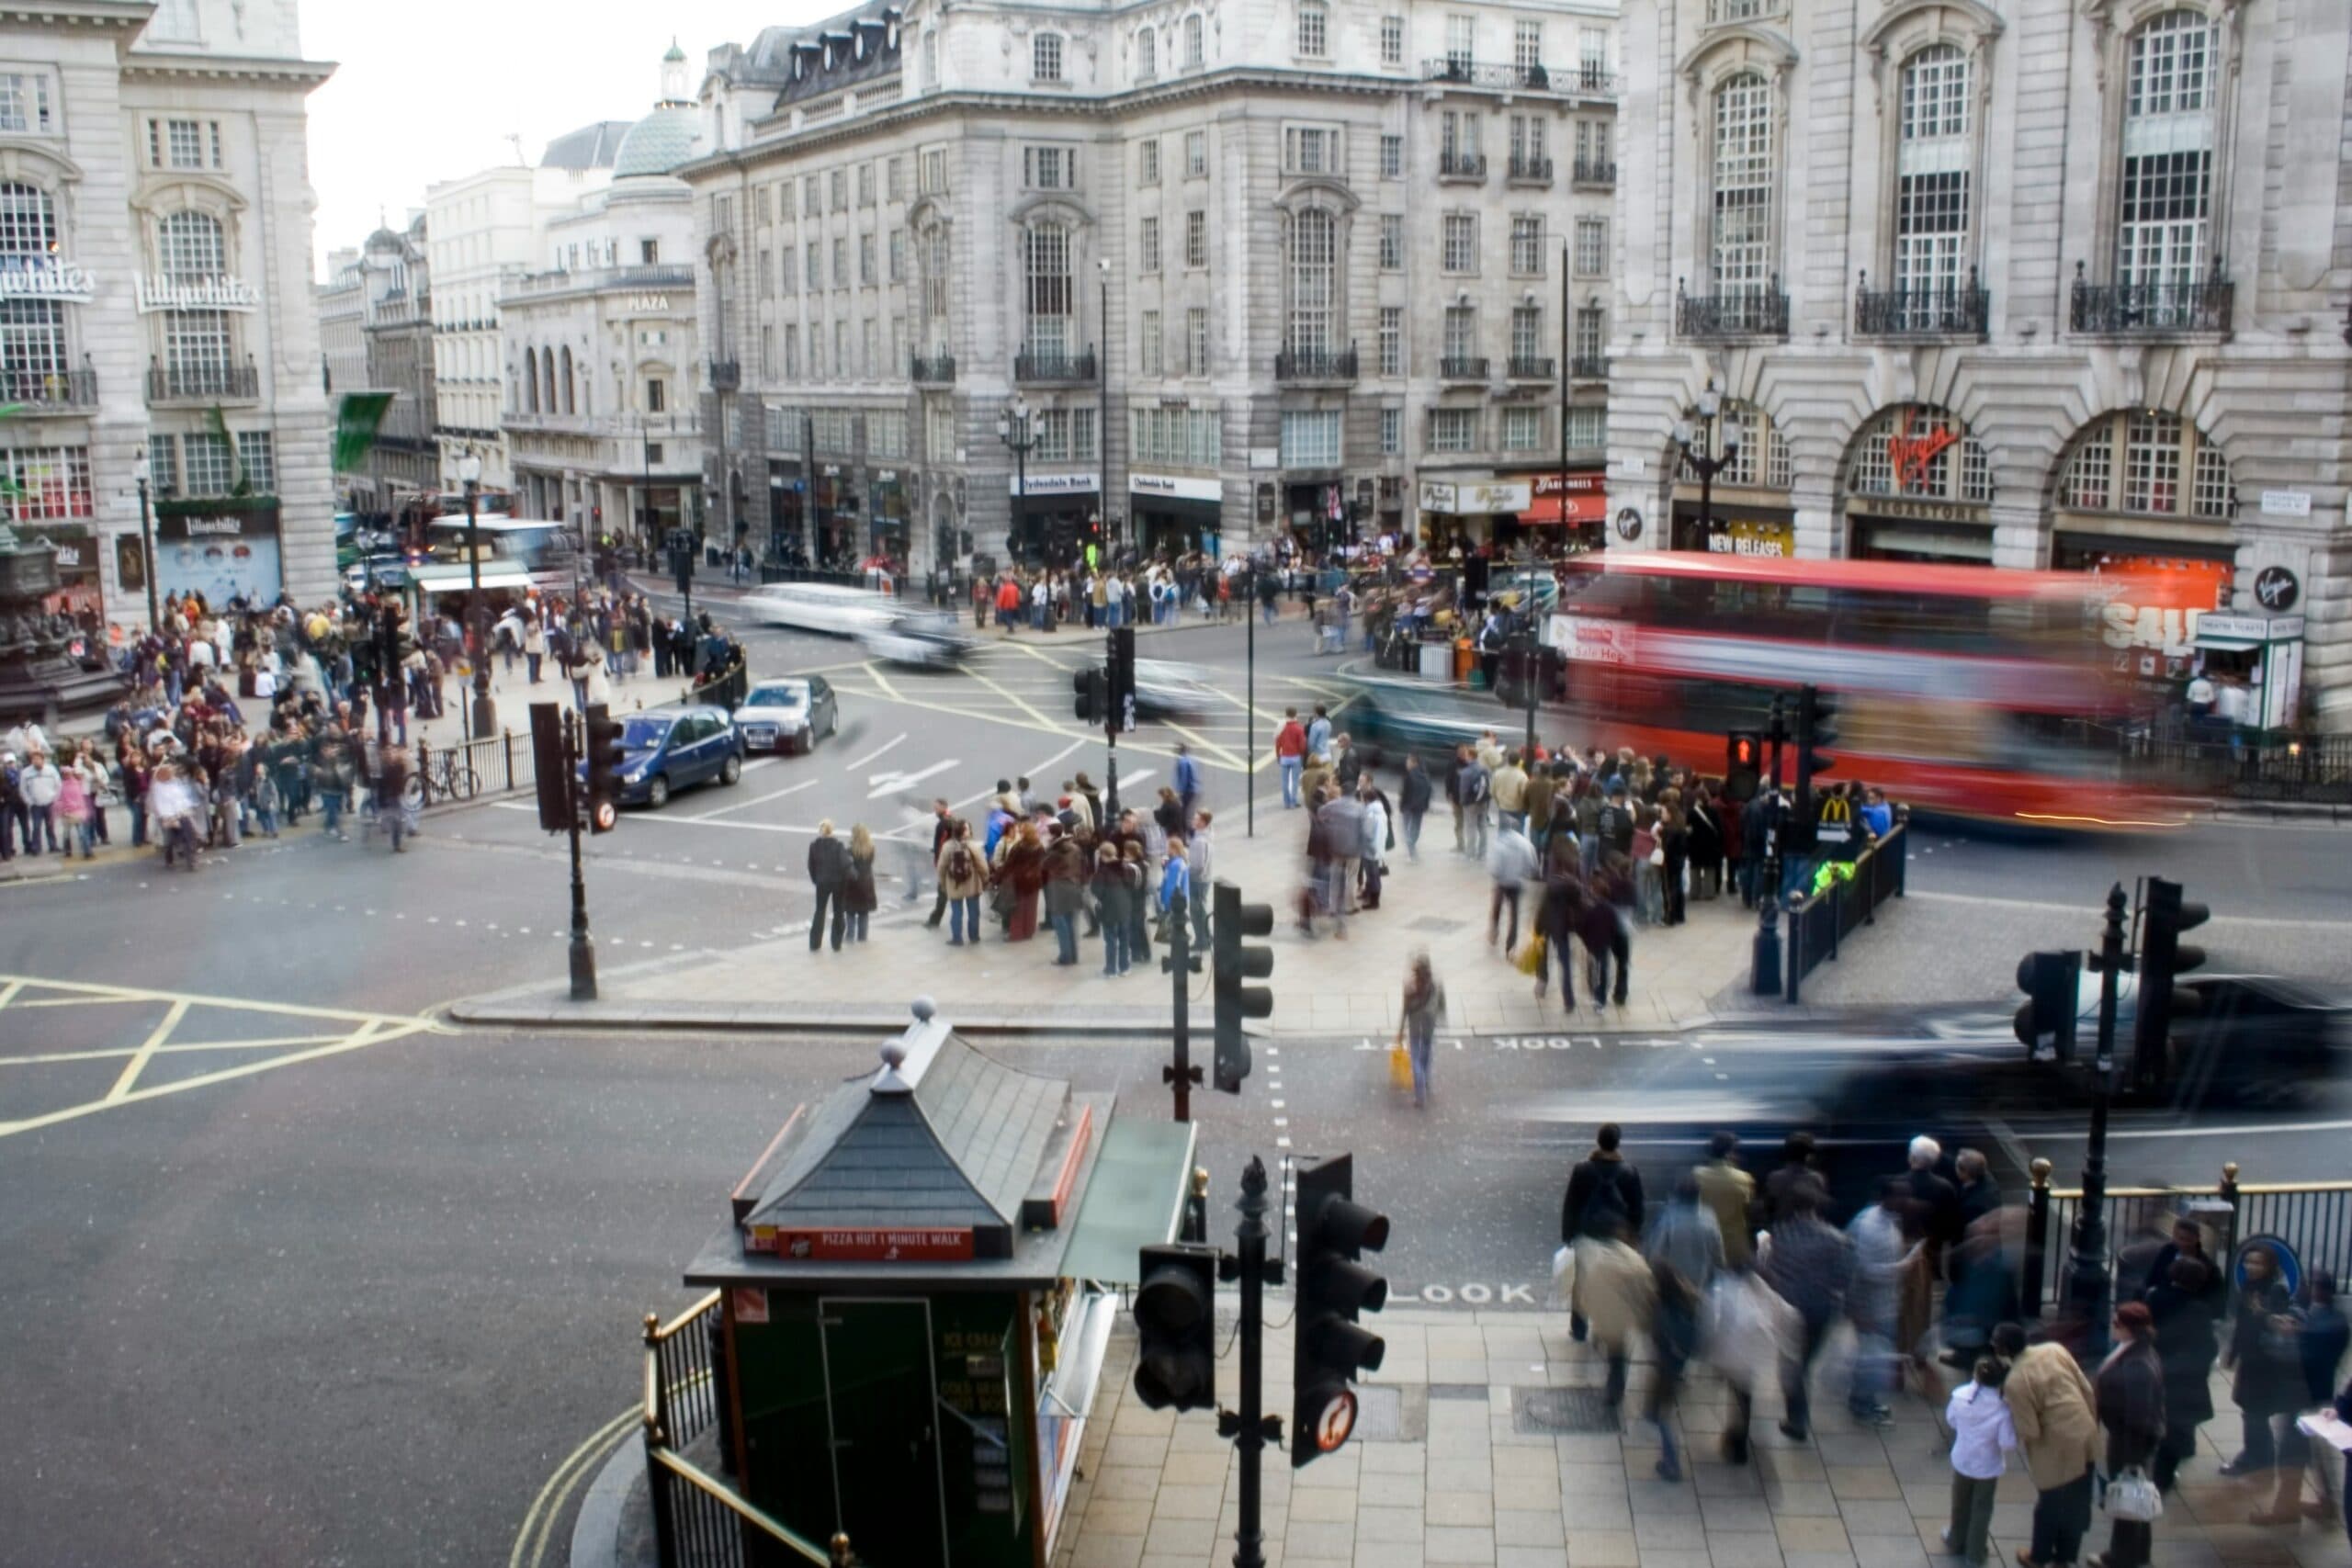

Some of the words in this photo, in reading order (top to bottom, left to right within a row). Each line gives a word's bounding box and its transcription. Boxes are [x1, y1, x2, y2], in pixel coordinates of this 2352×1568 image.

[628, 294, 669, 310] PLAZA
[1888, 406, 1959, 491] Virgin
[1069, 476, 1092, 488] Bank
[1867, 500, 1981, 521] MEGASTORE
[1709, 533, 1733, 552] NEW
[1735, 537, 1783, 559] RELEASES
[2257, 569, 2293, 606] Virgin
[1492, 1036, 1603, 1051] LOOK
[822, 1233, 854, 1246] PIZZA
[856, 1233, 877, 1246] HUT
[888, 1233, 928, 1247] MINUTE
[930, 1233, 962, 1247] WALK
[1385, 1283, 1535, 1303] LOOK
